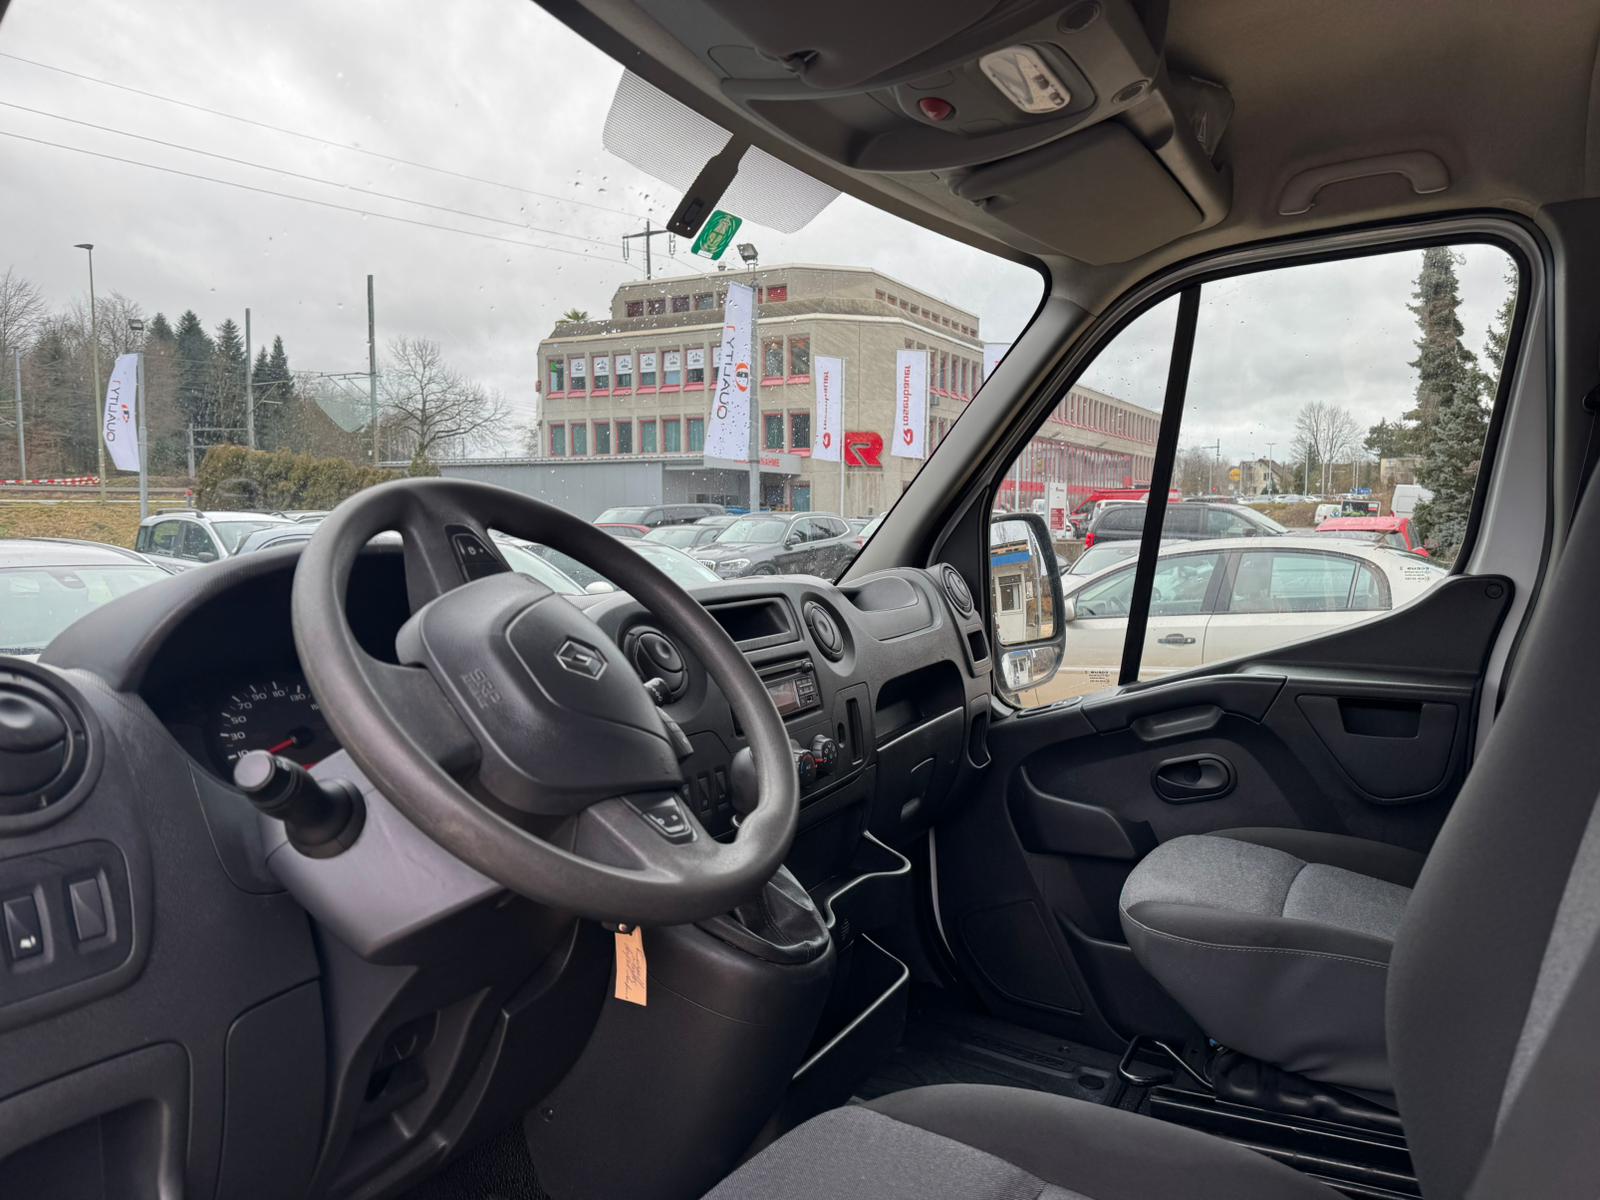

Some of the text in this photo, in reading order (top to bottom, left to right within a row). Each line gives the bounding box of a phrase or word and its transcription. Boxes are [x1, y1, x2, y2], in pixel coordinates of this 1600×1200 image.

[251, 692, 267, 701] 90
[289, 693, 306, 702] 130
[239, 702, 252, 710] 70
[231, 716, 247, 725] 50
[230, 731, 246, 741] 30
